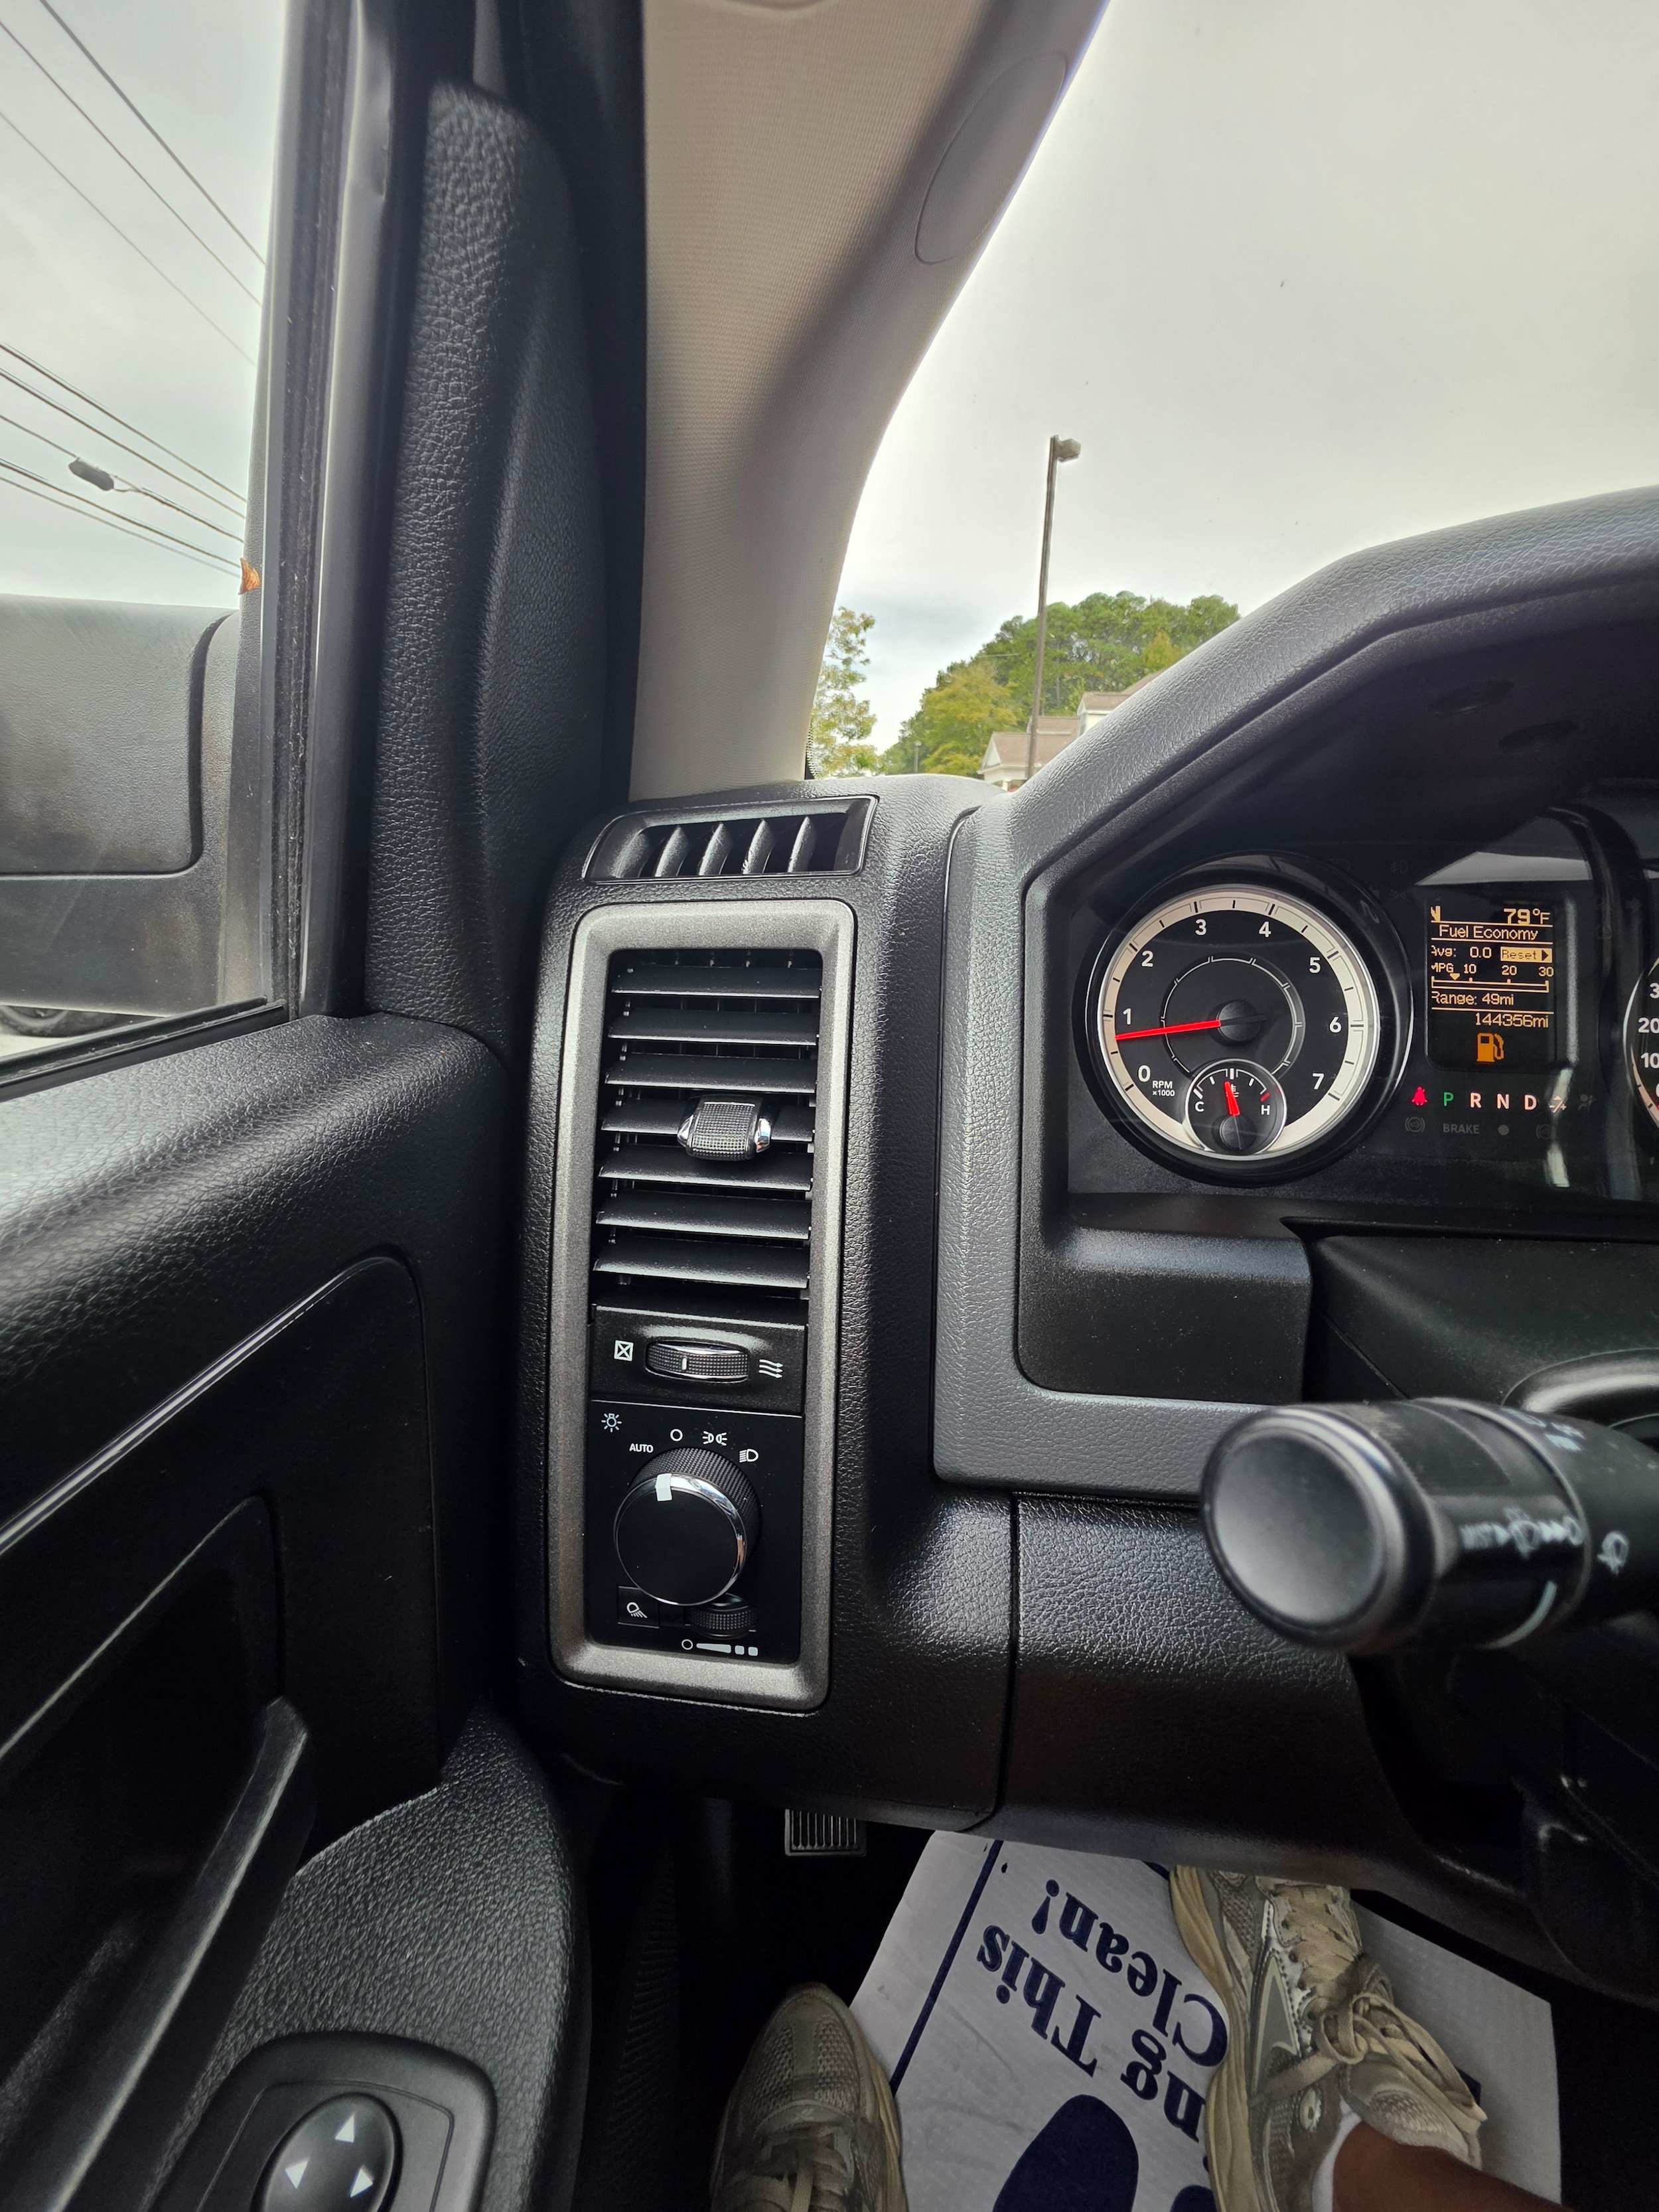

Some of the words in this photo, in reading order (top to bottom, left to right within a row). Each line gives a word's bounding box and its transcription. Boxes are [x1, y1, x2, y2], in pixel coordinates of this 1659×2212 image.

[1503, 908, 1551, 924] 79°F
[1194, 919, 1207, 936] 3
[1258, 921, 1271, 938] 4
[1439, 924, 1469, 938] Fuel
[1473, 925, 1539, 940] Economy
[1141, 950, 1154, 968] 2
[1431, 944, 1457, 957] Avg:
[1469, 946, 1492, 959] 0.0
[1502, 949, 1537, 960] Reset
[1309, 956, 1321, 974] 5
[1431, 962, 1455, 974] MPG
[1463, 963, 1477, 974] 10
[1501, 964, 1518, 976] 20
[1538, 966, 1554, 978] 30
[1431, 990, 1477, 1005] Range:
[1481, 992, 1514, 1005] 49mi
[1123, 1007, 1131, 1025] 1
[1329, 1016, 1342, 1033] 6
[1475, 1012, 1549, 1028] 144356mi
[1638, 1017, 1659, 1034] 20
[1640, 1052, 1659, 1069] 10
[1138, 1065, 1151, 1082] 0
[1312, 1072, 1325, 1090] 7
[1152, 1080, 1173, 1089] RPM
[1194, 1101, 1204, 1112] C
[1443, 1092, 1454, 1106] P
[1470, 1092, 1482, 1108] R
[1496, 1093, 1510, 1110] N
[1524, 1094, 1537, 1110] D
[1261, 1104, 1271, 1116] H
[1443, 1123, 1480, 1136] BRAKE
[629, 1443, 654, 1453] AUTO
[1031, 1879, 1228, 2067] Clean!
[976, 1924, 1101, 2077] This
[1119, 2028, 1208, 2142] ng
